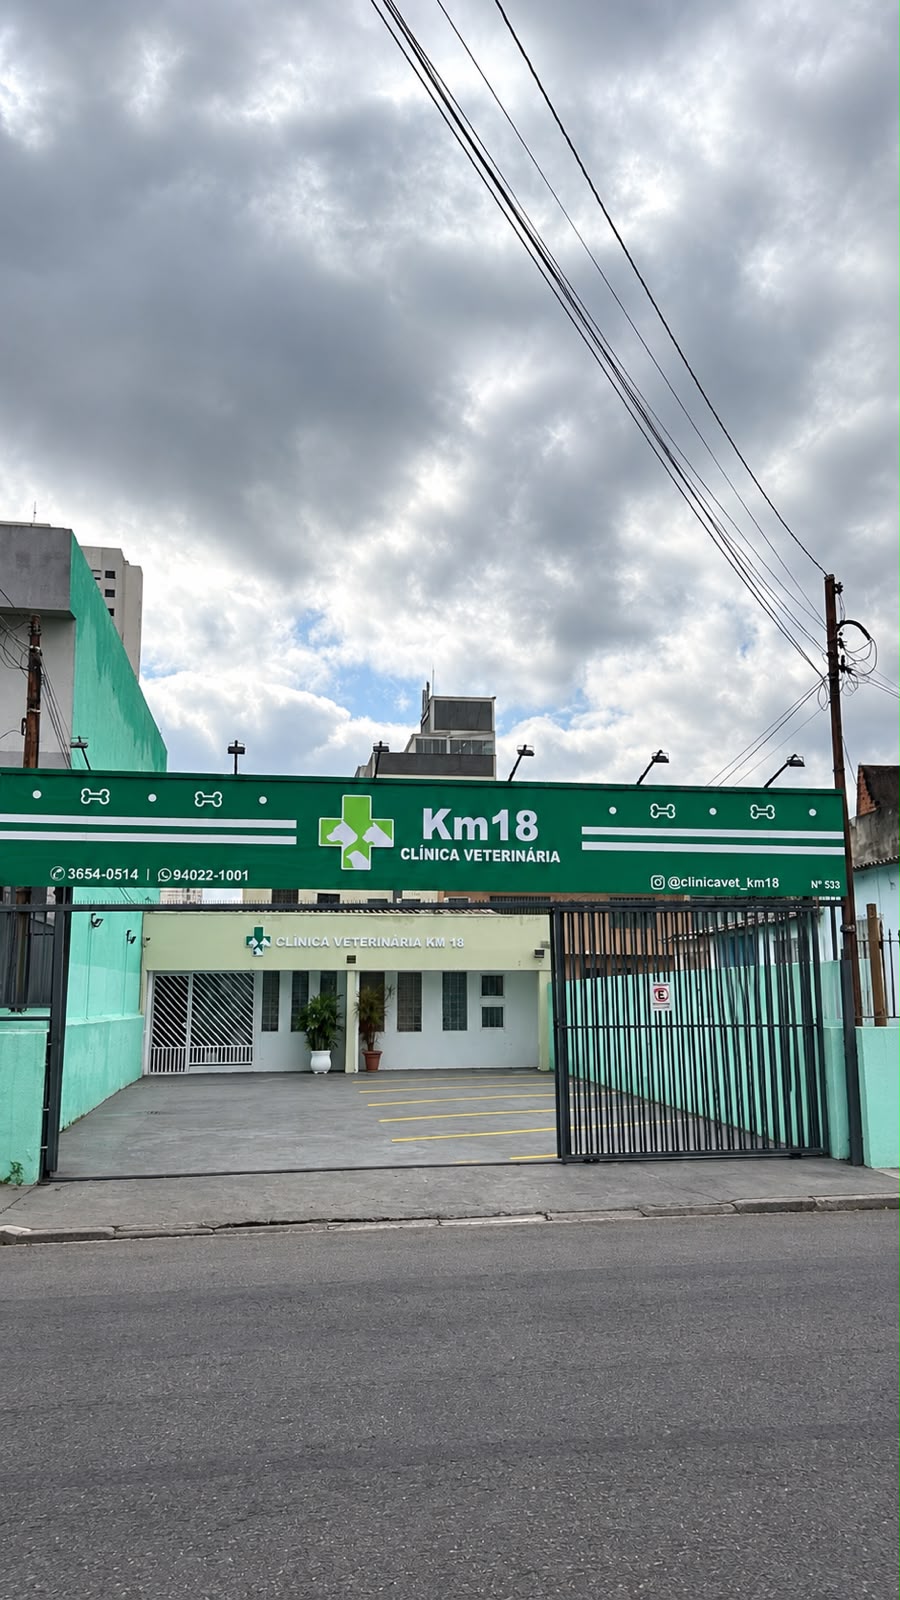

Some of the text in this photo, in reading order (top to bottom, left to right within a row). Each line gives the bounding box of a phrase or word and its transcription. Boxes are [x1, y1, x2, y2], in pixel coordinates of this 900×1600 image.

[422, 807, 539, 842] Km18
[400, 844, 561, 863] CLÍNICA VETERINÁRIA
[67, 868, 249, 881] 3654-0514 94022-1001
[667, 875, 780, 890] @clinicavet_km18
[275, 934, 465, 948] CLÍNICA VETERINÁRIA KM 18
[657, 990, 665, 1000] E
